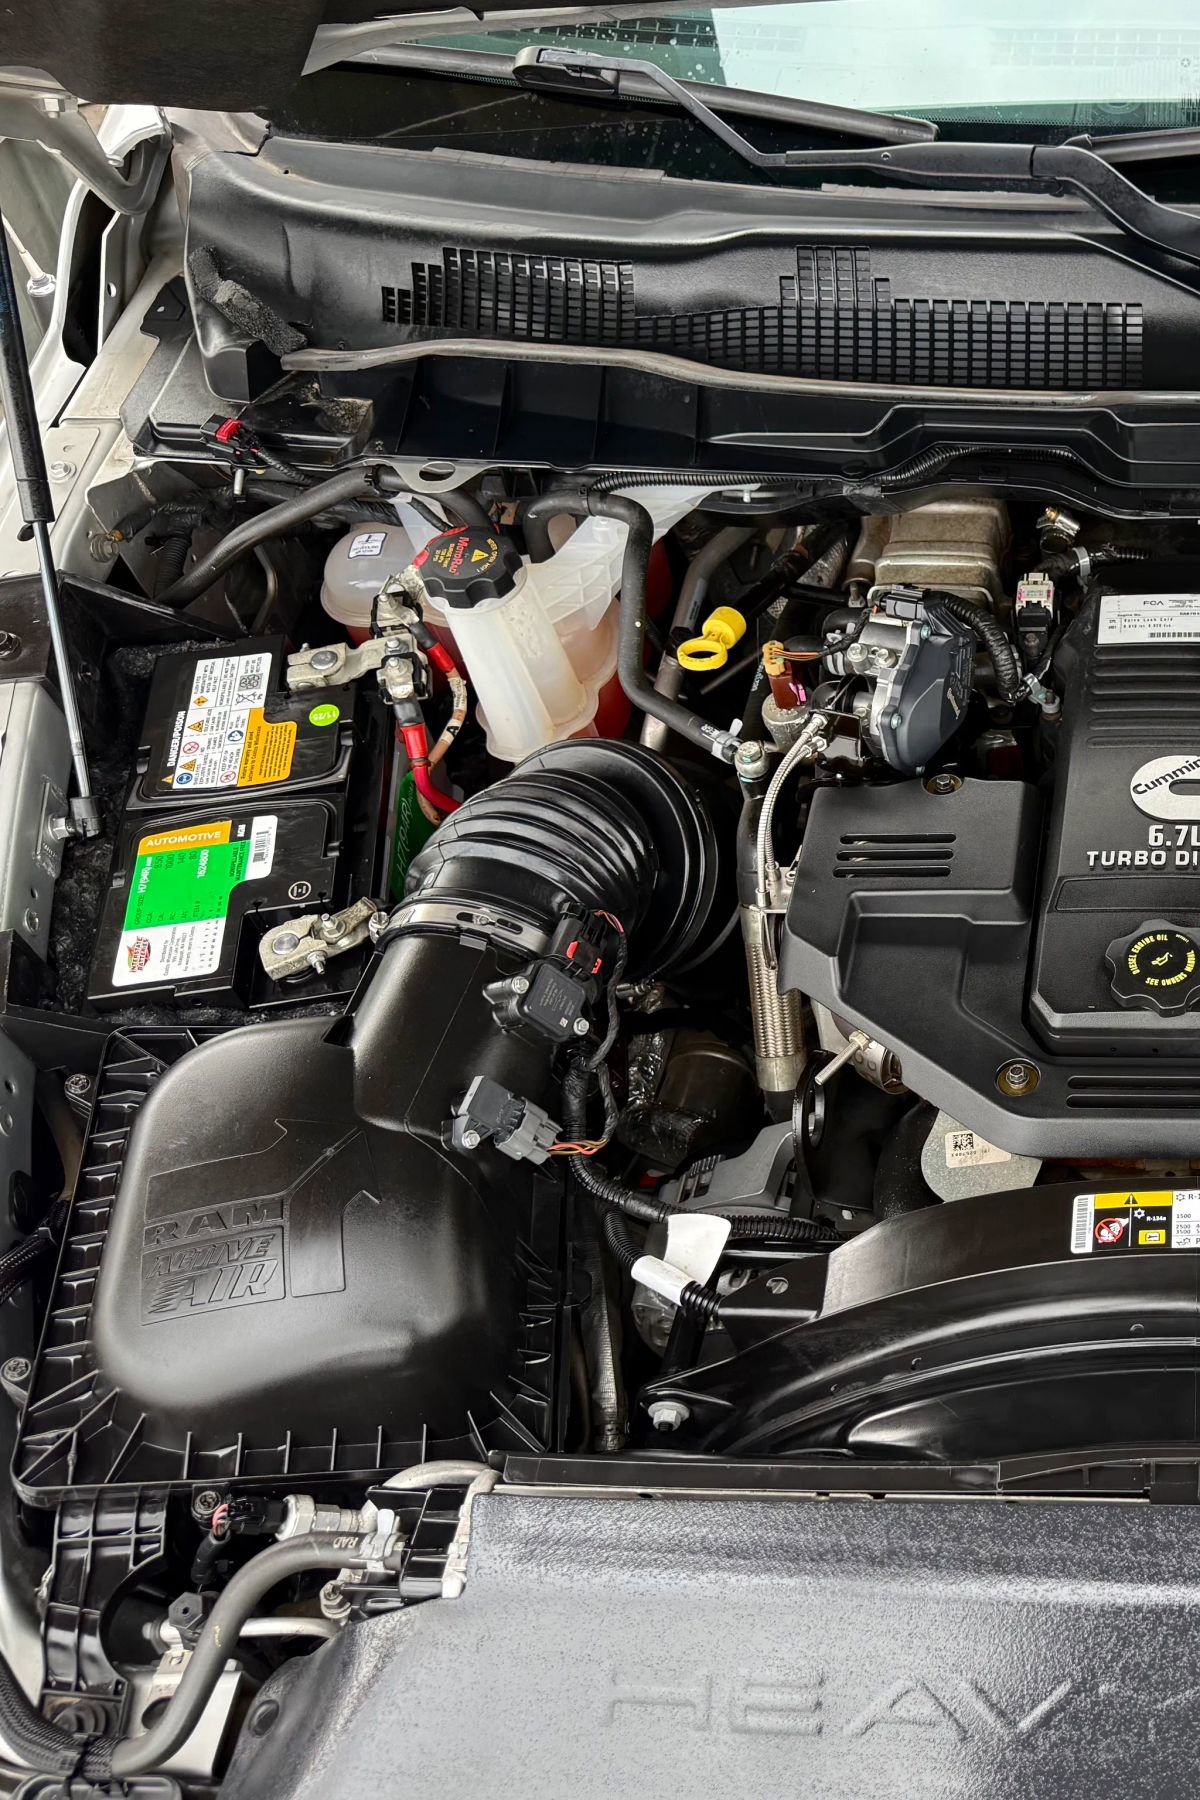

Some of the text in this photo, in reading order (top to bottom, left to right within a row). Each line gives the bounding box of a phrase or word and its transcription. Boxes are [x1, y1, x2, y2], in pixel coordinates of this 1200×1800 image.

[446, 724, 460, 740] A
[145, 829, 223, 848] AUTOMOTIVE
[153, 855, 164, 870] 850
[164, 853, 176, 870] 1000
[176, 852, 187, 865] 140
[188, 850, 198, 861] 80
[196, 848, 210, 879] 1624800
[1086, 850, 1168, 868] TURBO
[1131, 935, 1156, 954] ENGINE
[1156, 934, 1169, 942] OIL
[129, 935, 144, 973] INTERSTATE
[137, 939, 149, 971] BATTERIES
[1127, 953, 1141, 975] DIESEL
[1145, 977, 1160, 986] SEE
[1161, 972, 1188, 986] OWNERS
[143, 1200, 284, 1248] RAM
[145, 1233, 276, 1280] ACTIVE
[150, 1258, 279, 1313] AIR
[332, 1536, 358, 1549] RAD
[604, 1664, 1195, 1745] HEAVY
